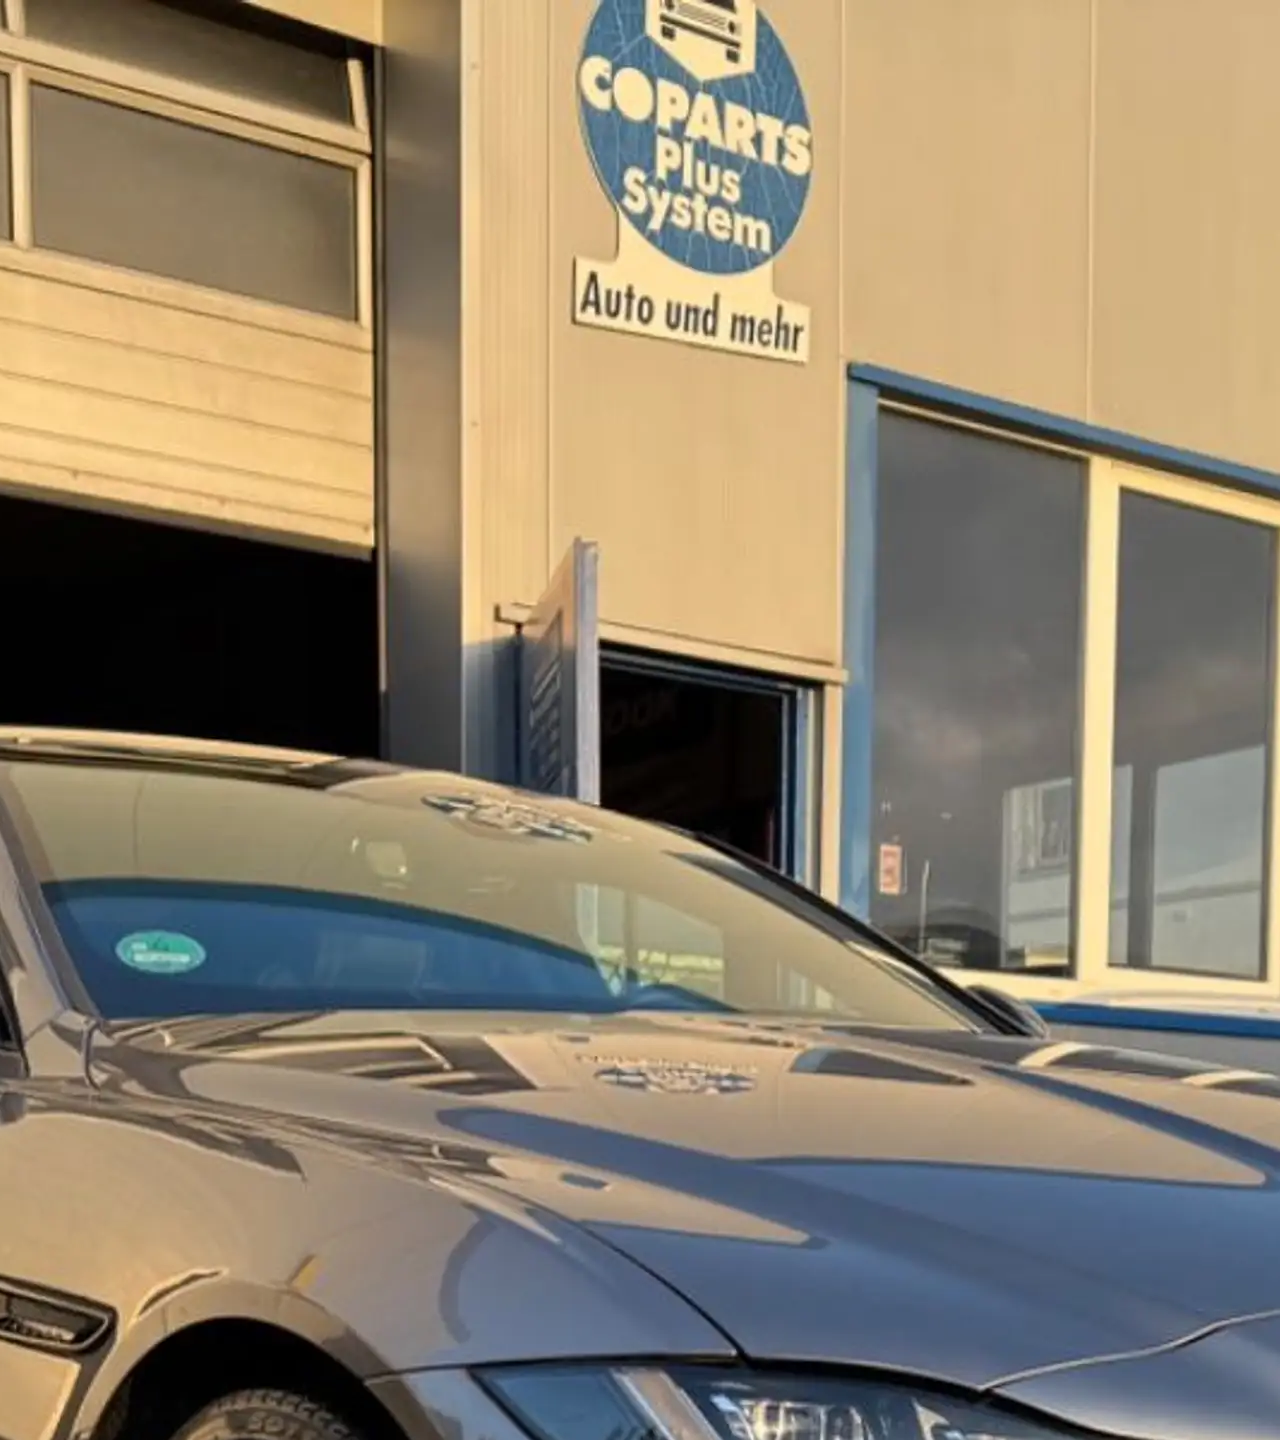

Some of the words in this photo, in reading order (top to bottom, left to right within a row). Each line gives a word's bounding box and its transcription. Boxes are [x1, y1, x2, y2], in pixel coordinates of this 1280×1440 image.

[580, 55, 812, 176] COPARTS
[622, 166, 771, 253] System
[656, 134, 741, 203] Plus
[580, 270, 655, 326] Auto
[665, 292, 719, 338] und
[730, 304, 805, 354] mehr
